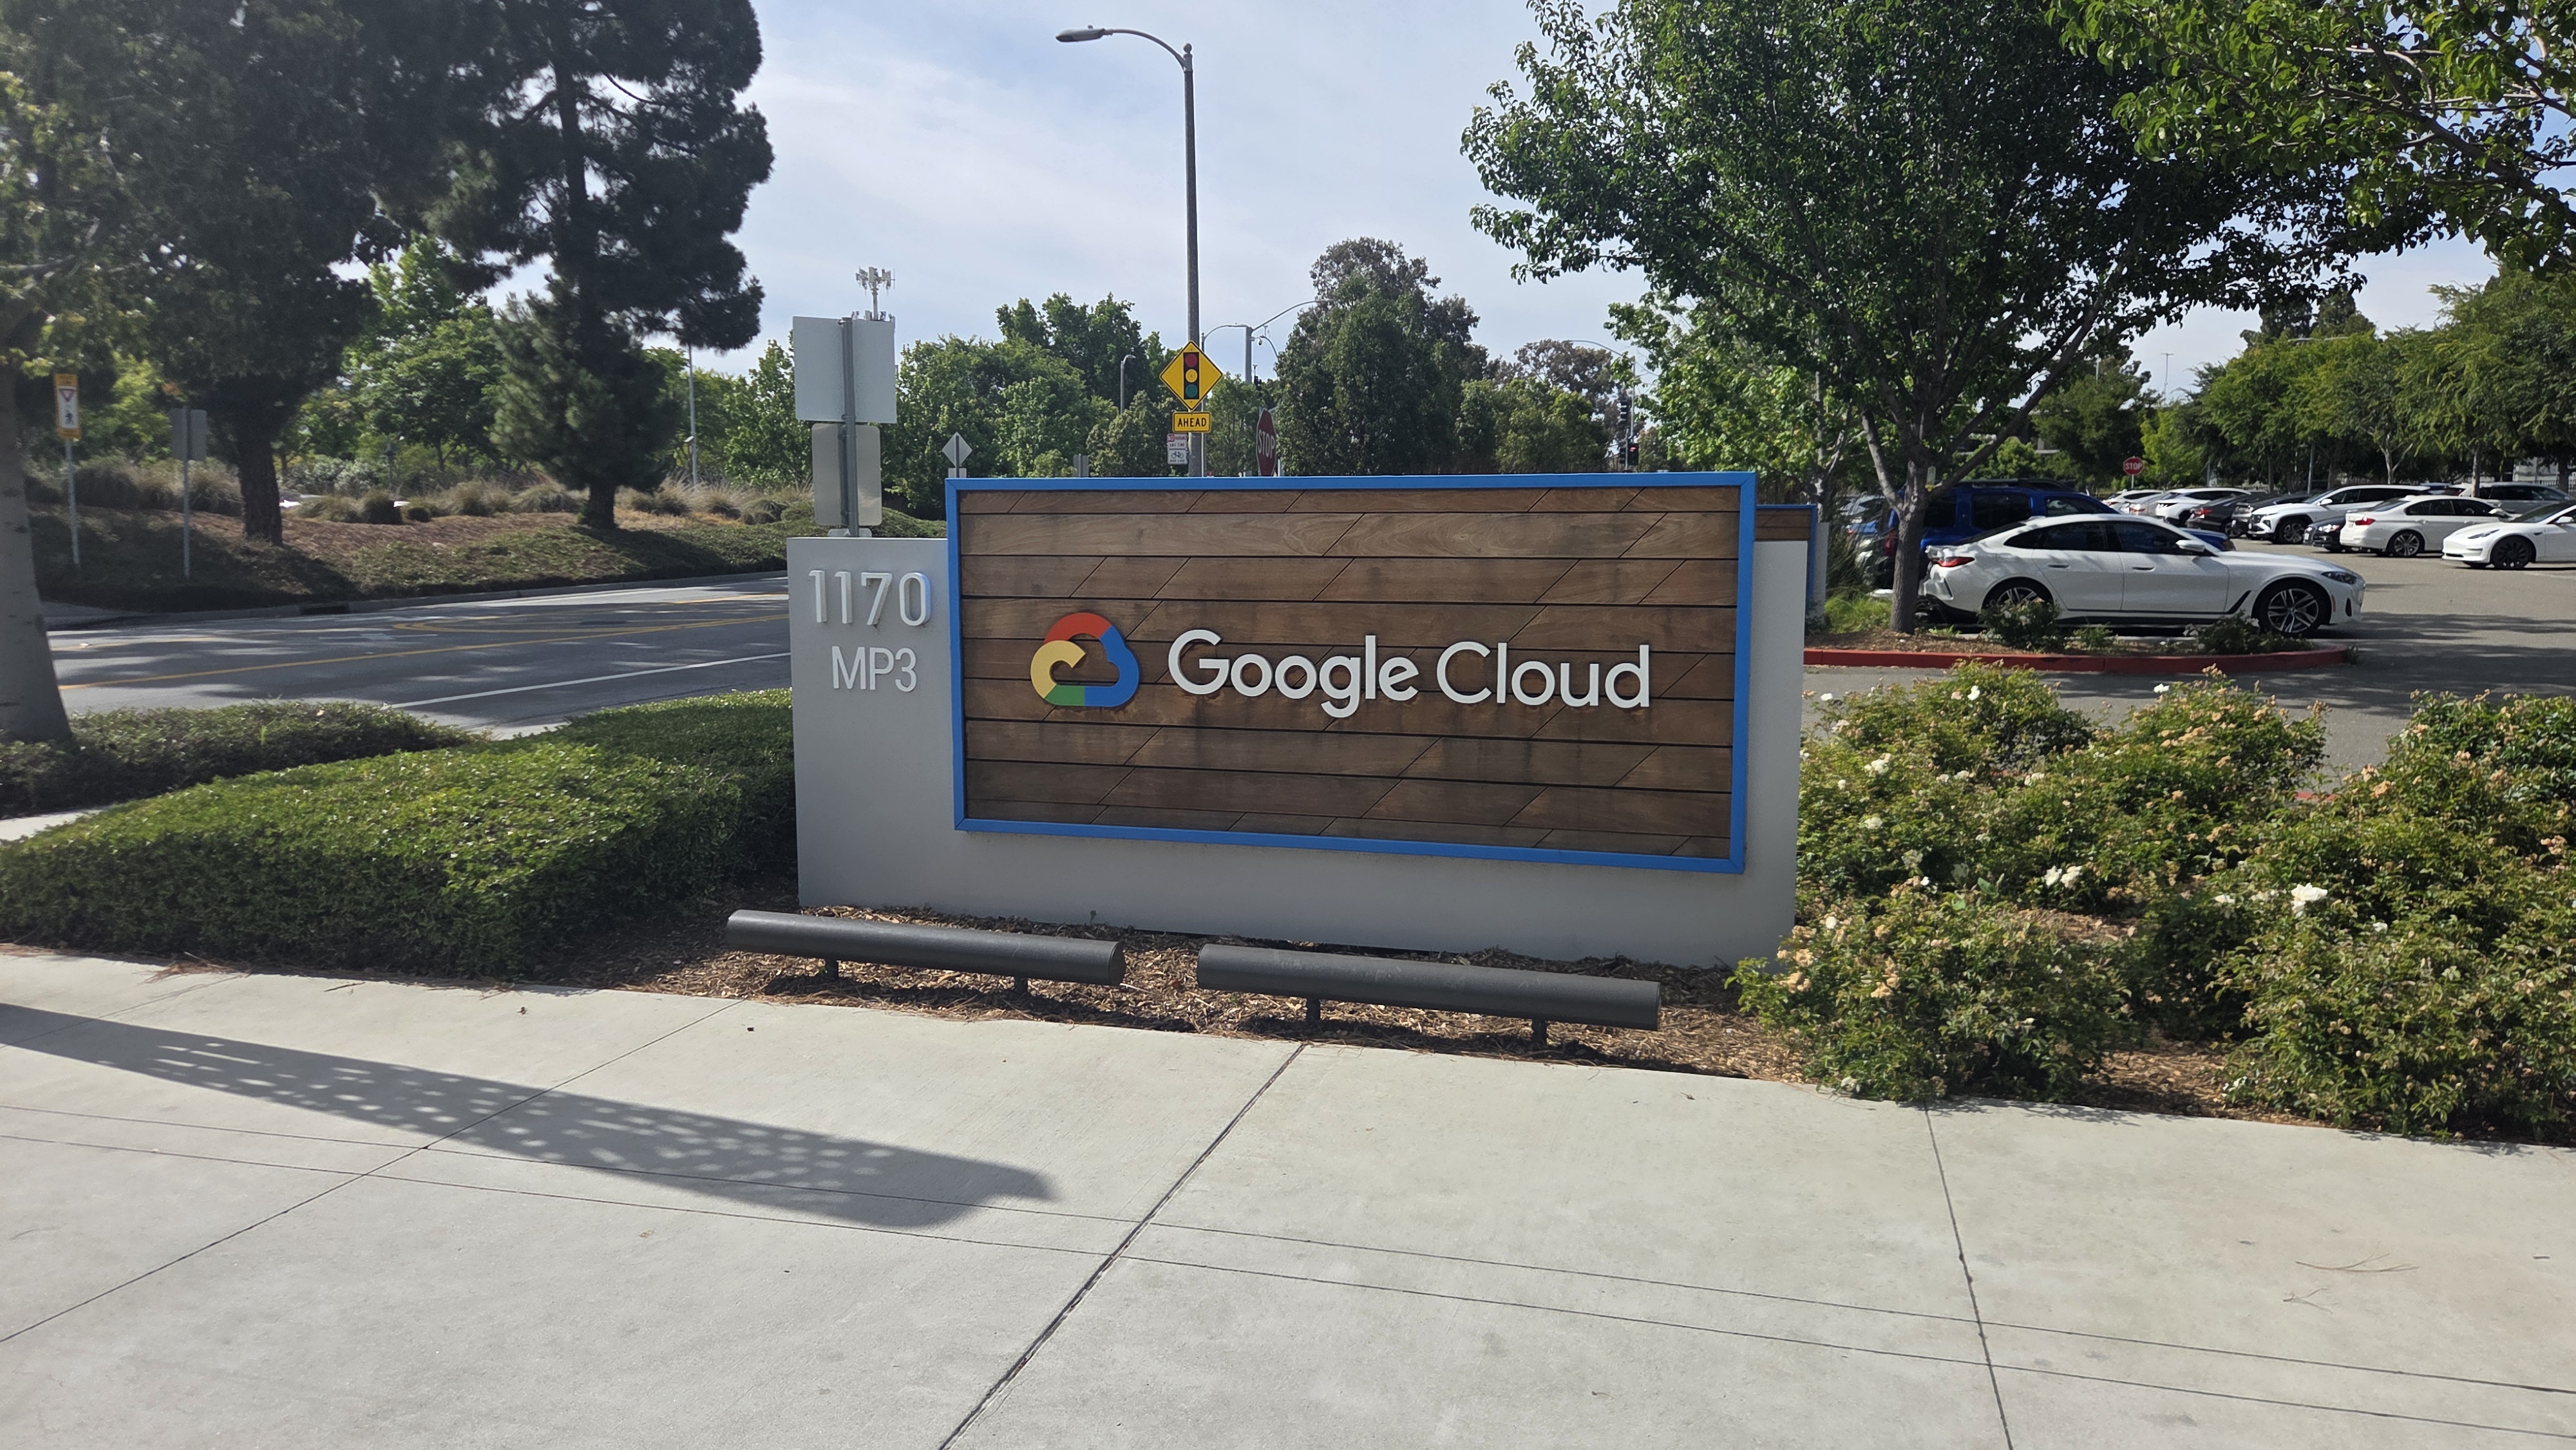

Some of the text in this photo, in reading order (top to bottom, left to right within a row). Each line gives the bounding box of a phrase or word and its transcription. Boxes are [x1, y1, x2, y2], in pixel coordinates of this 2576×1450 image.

[1177, 417, 1207, 427] AHEAD
[1258, 429, 1275, 458] STOP
[809, 570, 931, 626] 1170
[831, 646, 917, 692] MP3
[1168, 628, 1651, 719] Google Cloud
